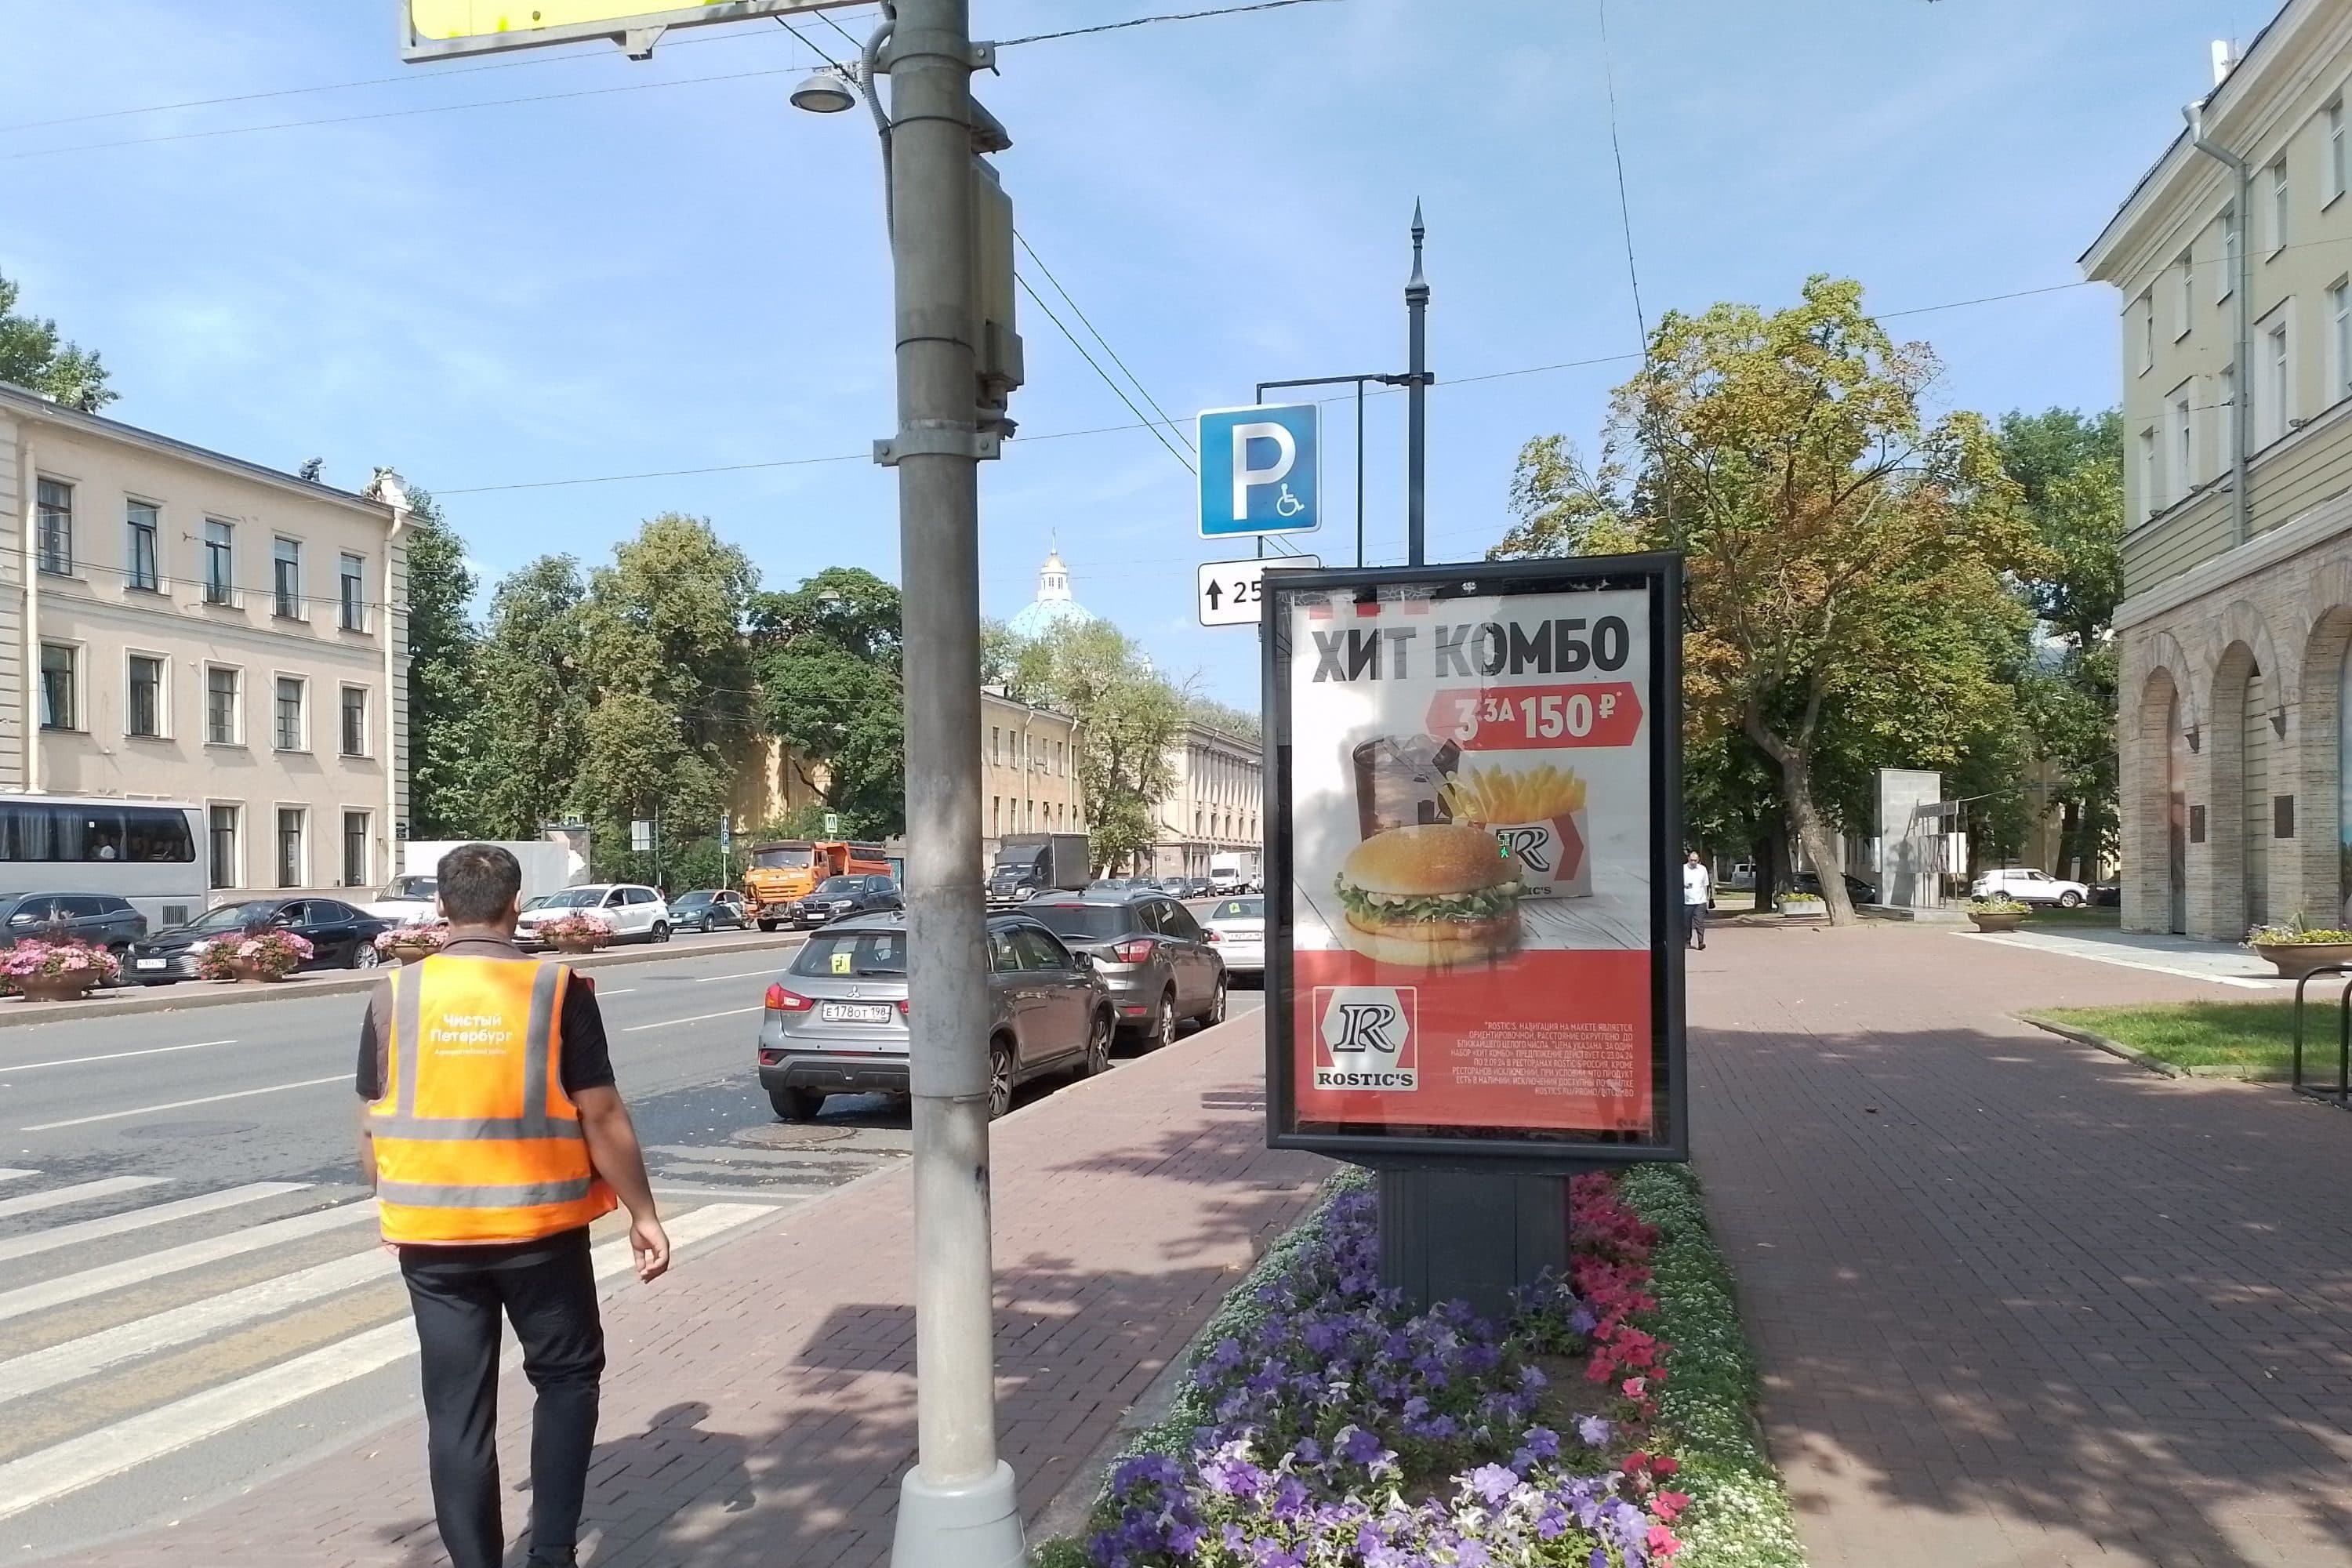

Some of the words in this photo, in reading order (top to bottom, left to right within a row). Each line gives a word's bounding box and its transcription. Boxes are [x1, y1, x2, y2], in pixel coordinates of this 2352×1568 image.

[1232, 422, 1296, 521] P
[1312, 626, 1417, 683] ХИТ
[1435, 615, 1630, 677] КОМБО
[1454, 699, 1479, 741] 3
[1483, 697, 1515, 722] ЗА
[1519, 694, 1593, 739] 150
[443, 1011, 502, 1027] Чистый
[430, 1029, 514, 1045] Петербург
[1318, 1073, 1414, 1087] ROSTIC'S
